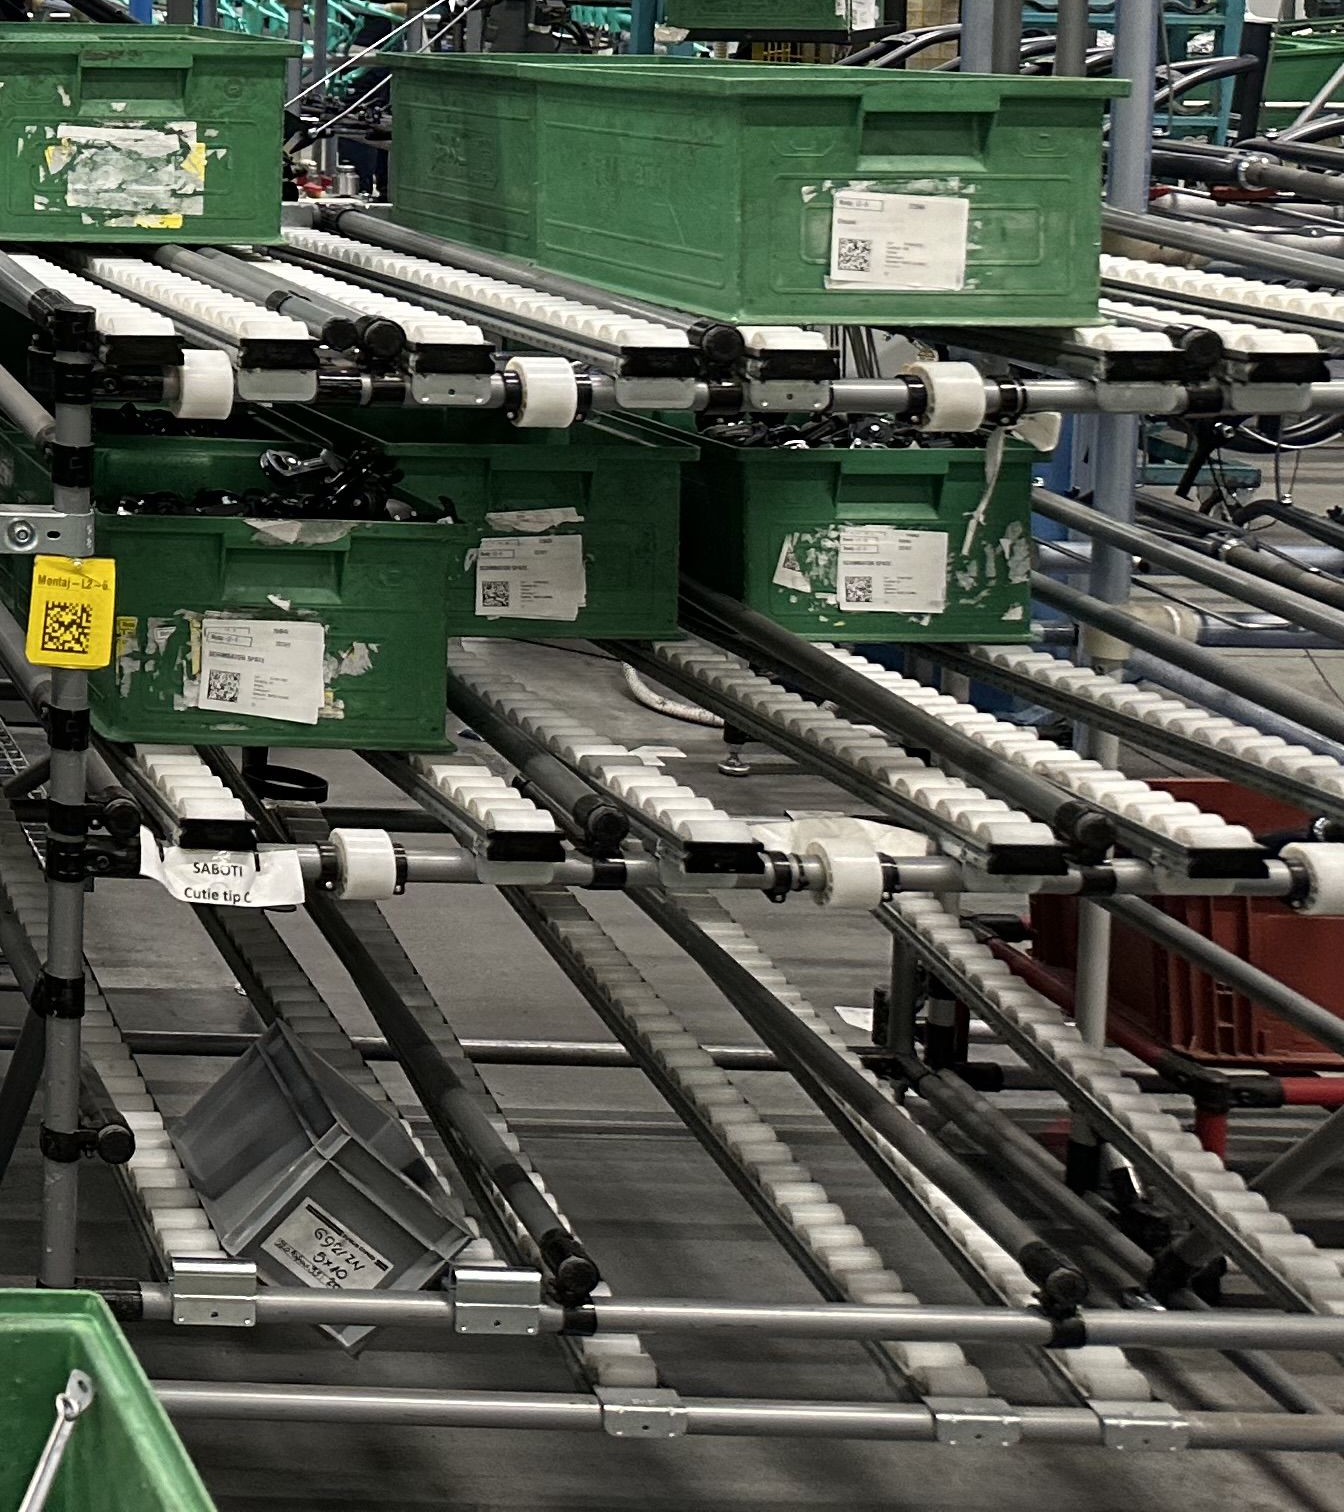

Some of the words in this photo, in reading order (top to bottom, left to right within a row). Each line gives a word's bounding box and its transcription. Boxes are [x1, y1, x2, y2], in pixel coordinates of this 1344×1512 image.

[37, 574, 71, 590] Montaj
[193, 861, 243, 878] SABOTI
[184, 887, 219, 901] Cutie
[223, 889, 241, 905] tip
